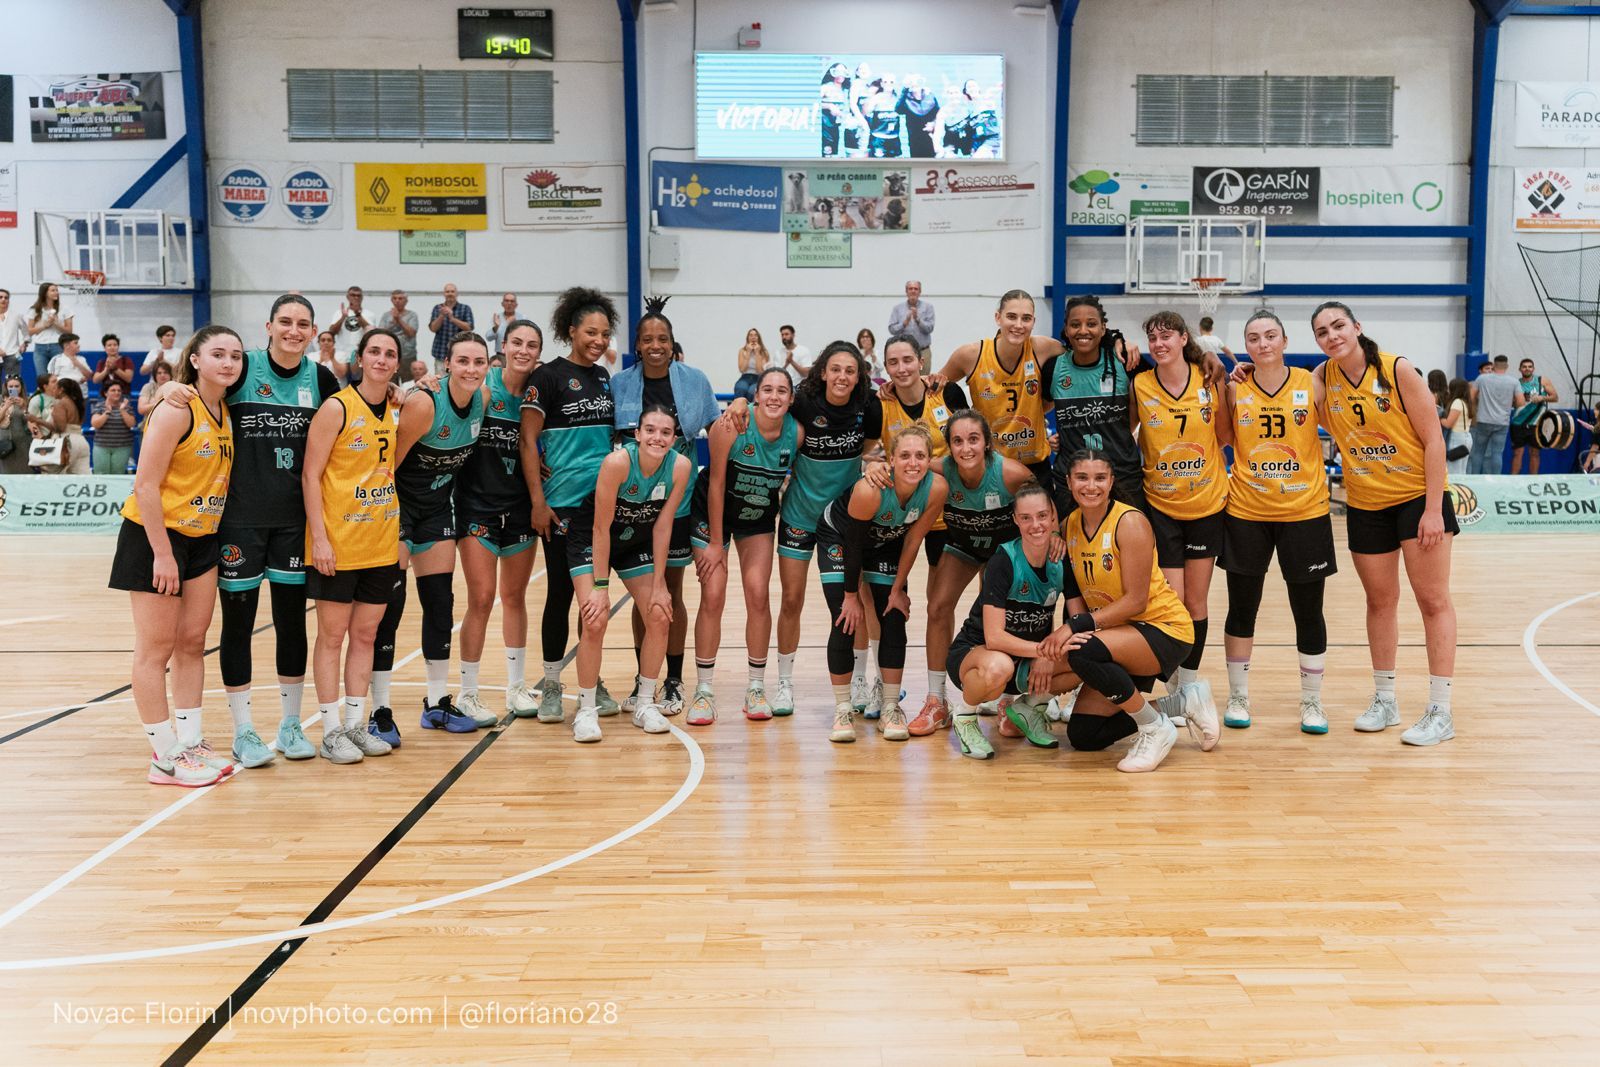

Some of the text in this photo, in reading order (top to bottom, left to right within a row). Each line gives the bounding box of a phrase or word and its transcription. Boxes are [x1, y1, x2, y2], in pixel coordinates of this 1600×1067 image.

[463, 9, 490, 17] LOCALES
[486, 37, 531, 55] 19:40
[228, 176, 262, 186] RADIO
[292, 178, 323, 188] RADIO
[405, 176, 478, 188] ROMBOSOL
[1246, 170, 1310, 190] GARÍN
[224, 188, 266, 201] MARCA
[288, 190, 329, 203] MARCA
[714, 184, 778, 198] achedosol
[1246, 190, 1309, 203] Ingenieros
[1326, 189, 1404, 208] hospiten
[1219, 205, 1293, 214] 952 80 45 72
[1006, 389, 1018, 413] 3
[1352, 403, 1366, 426] 9
[1174, 414, 1187, 438] 7
[1258, 414, 1286, 438] 33
[1002, 428, 1035, 442] corda
[1083, 433, 1103, 450] 10
[1360, 444, 1397, 455] corda
[274, 447, 294, 469] 13
[1261, 459, 1300, 471] corda
[62, 483, 108, 498] CAB
[355, 486, 367, 499] la
[1528, 482, 1572, 497] CAB
[19, 502, 124, 516] ESTEPON
[738, 506, 764, 521] 20
[1494, 500, 1600, 515] ESTEPON
[970, 535, 992, 548] 77
[1083, 560, 1096, 585] 11
